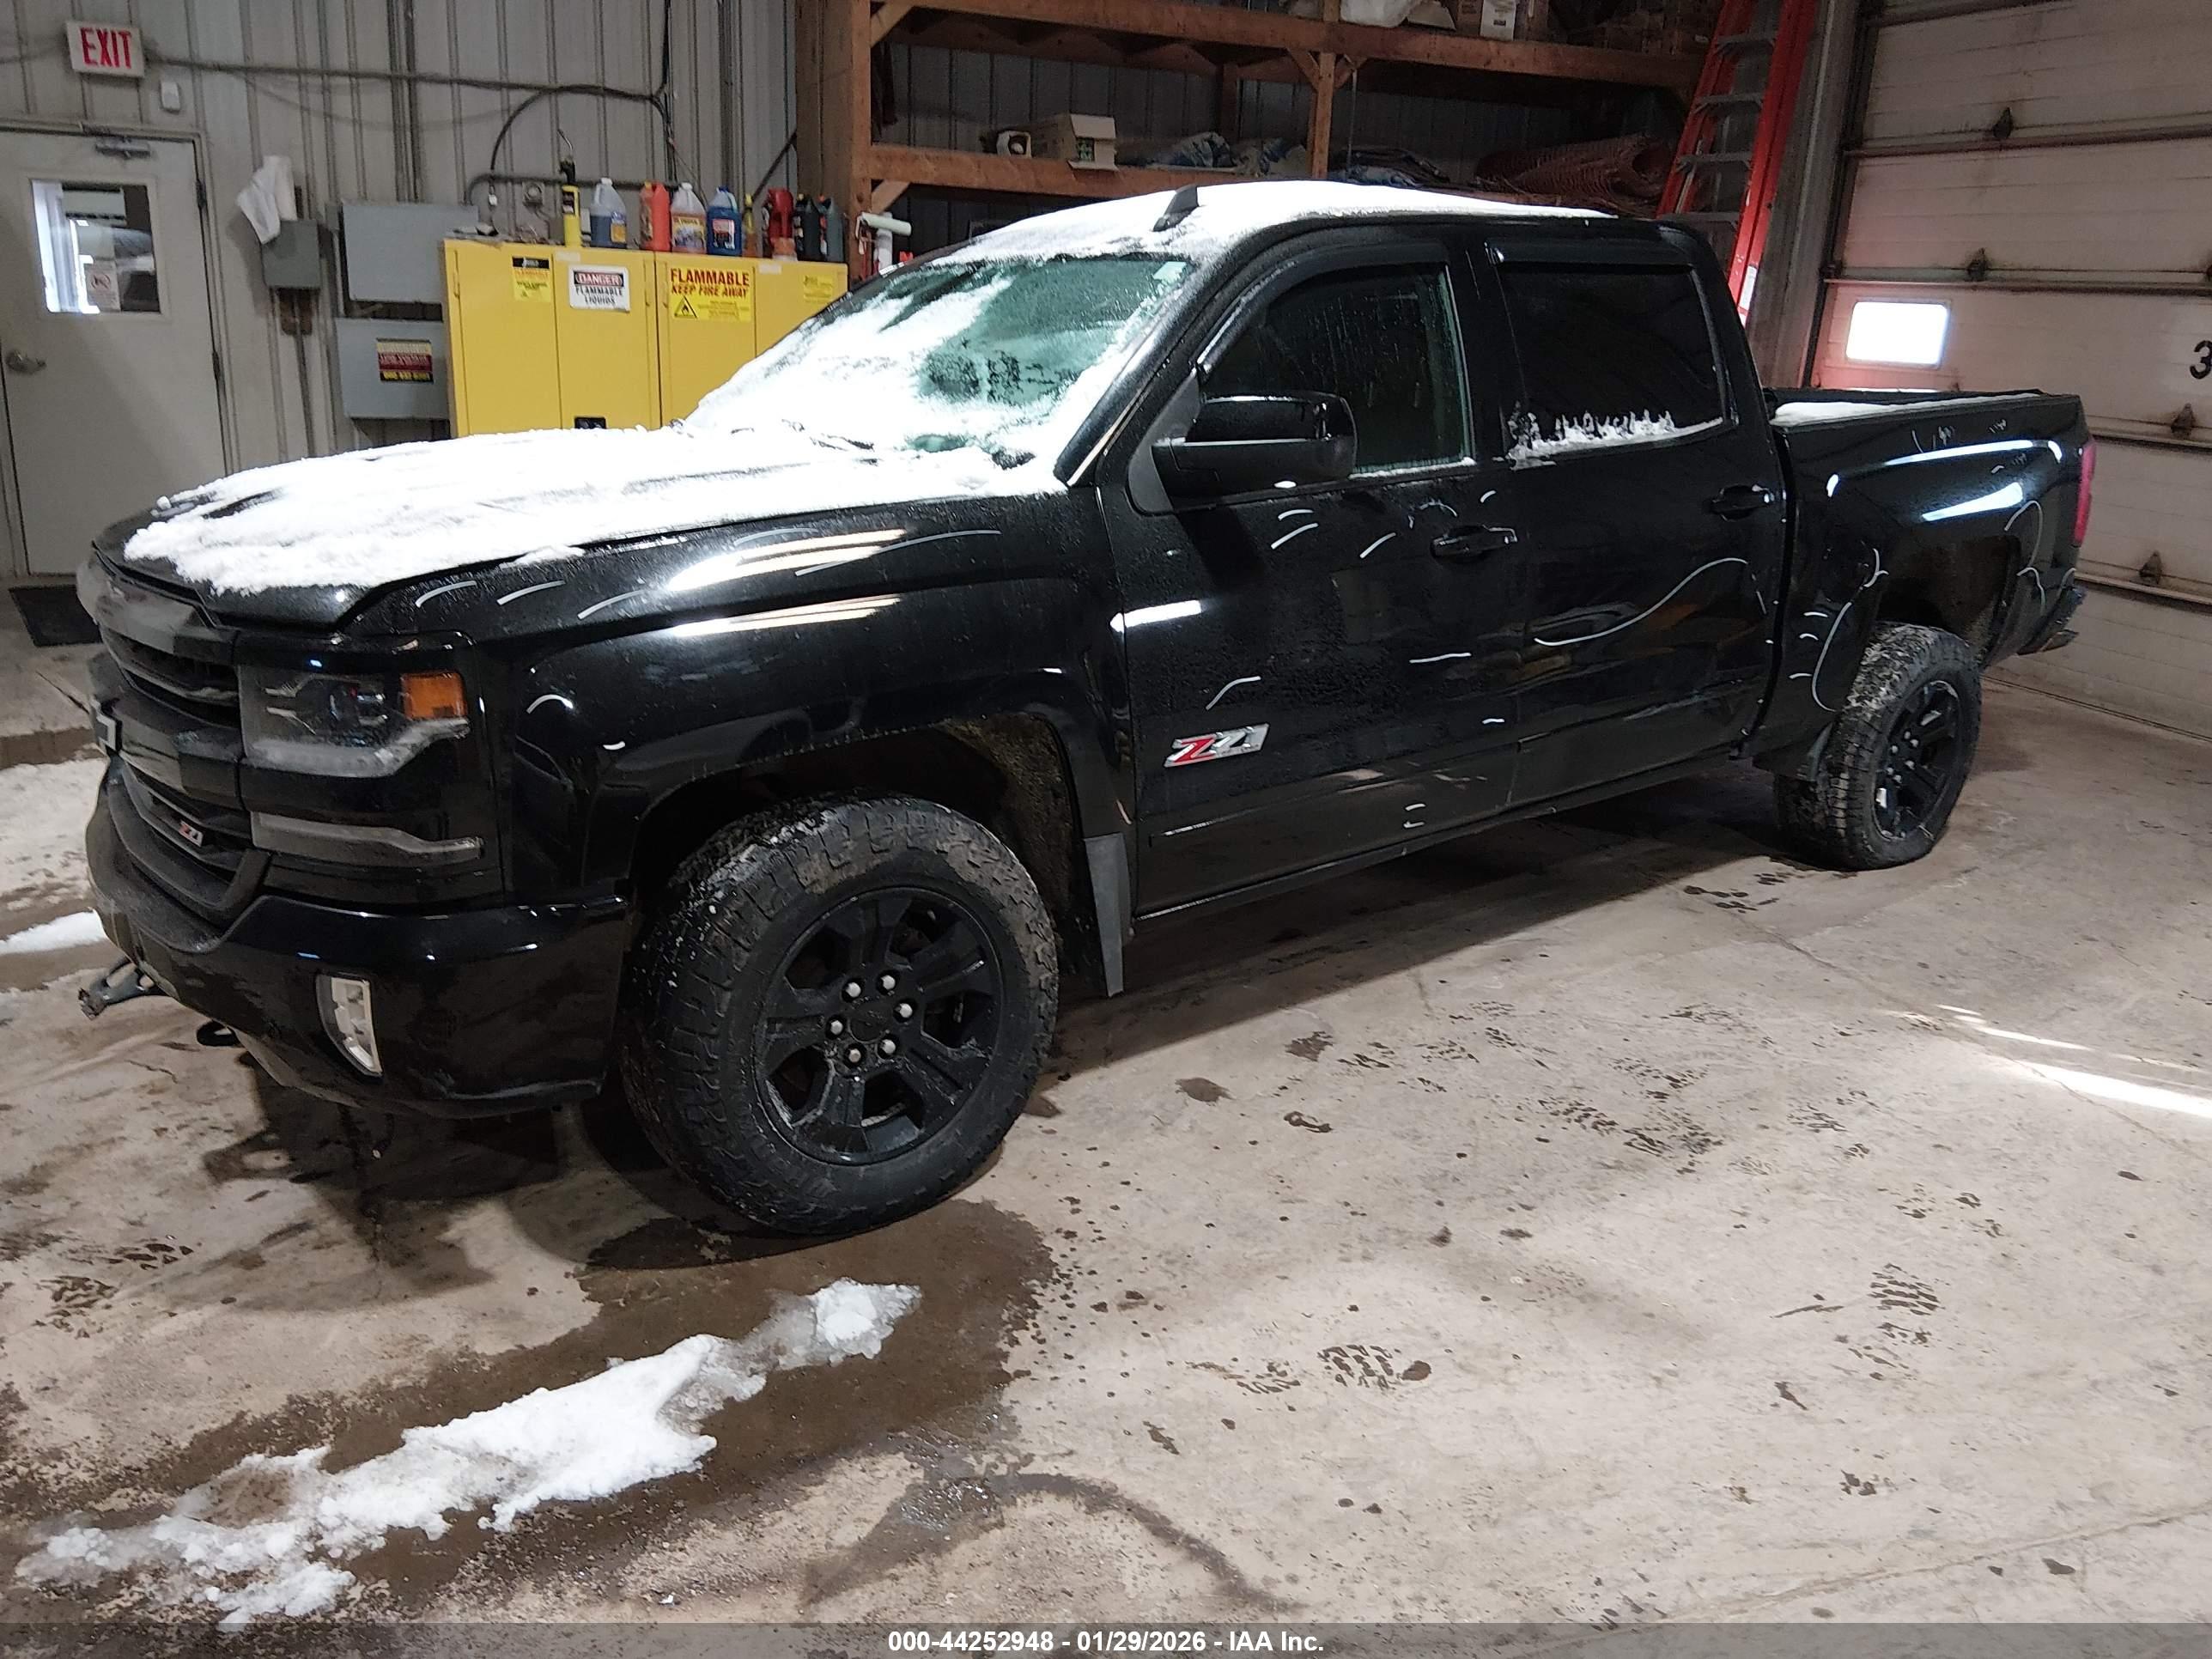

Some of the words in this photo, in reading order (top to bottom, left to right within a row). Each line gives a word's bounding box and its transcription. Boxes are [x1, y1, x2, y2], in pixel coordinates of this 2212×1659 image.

[80, 27, 132, 70] EXIT
[576, 273, 620, 286] DANGER
[670, 268, 750, 287] FLAMMABLE
[575, 285, 623, 296] FLAMMABLE
[672, 284, 696, 295] KEEP
[2190, 340, 2212, 380] 3
[1164, 723, 1269, 768] Z71
